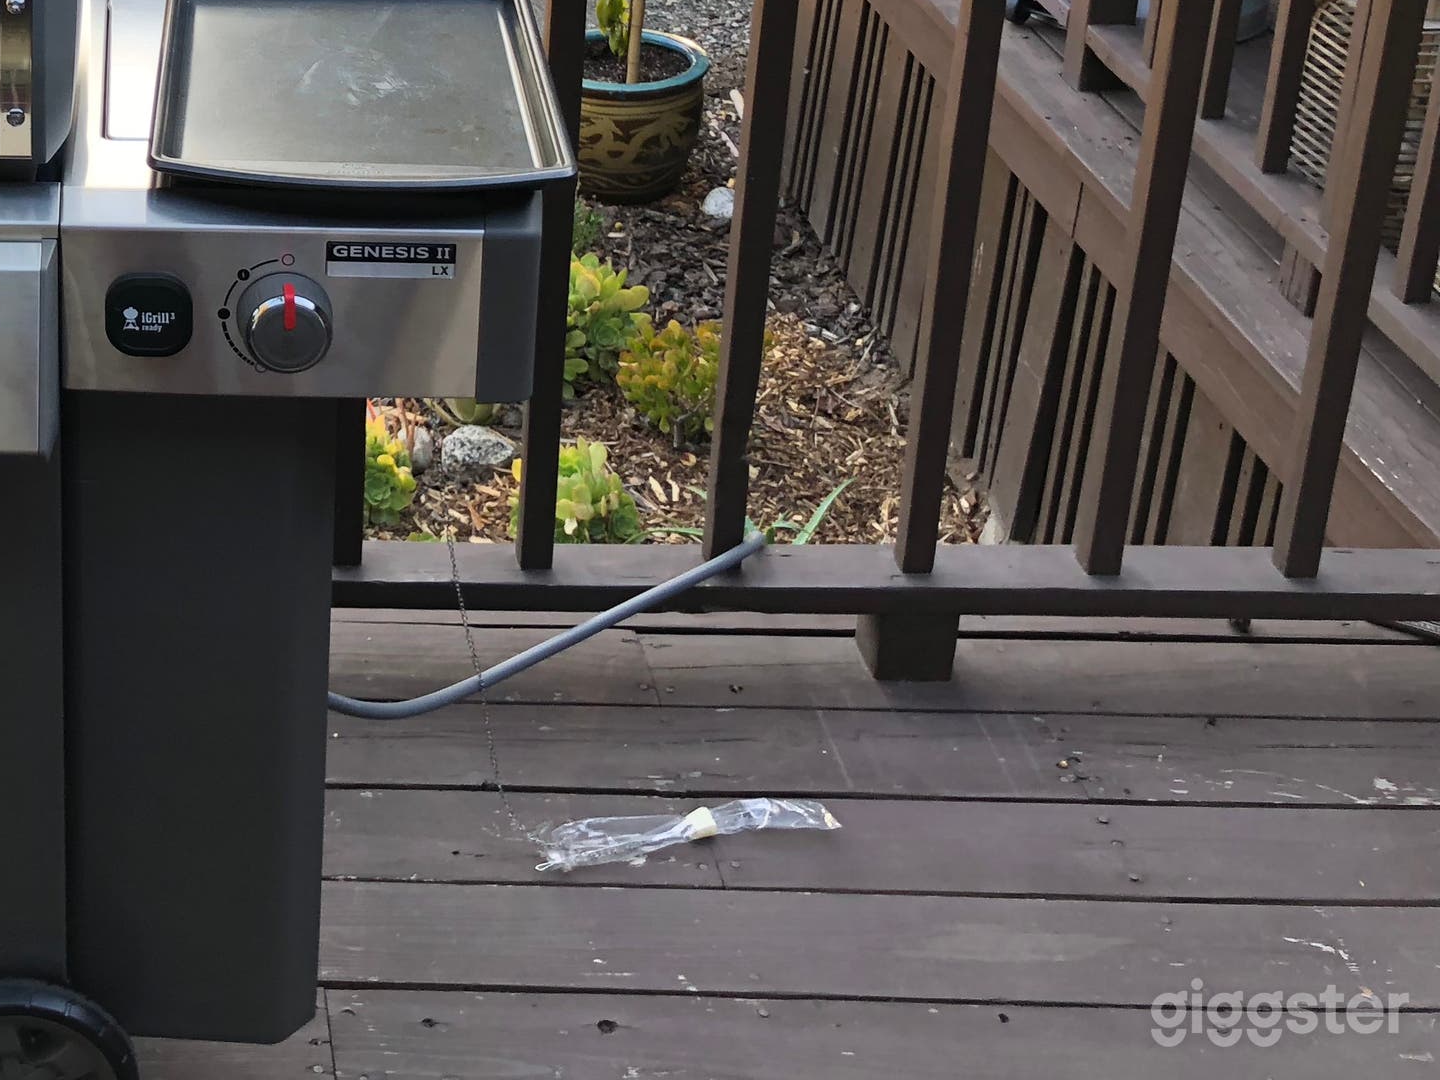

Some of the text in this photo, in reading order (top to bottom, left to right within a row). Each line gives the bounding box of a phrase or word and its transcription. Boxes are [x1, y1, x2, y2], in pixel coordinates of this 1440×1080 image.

[332, 245, 451, 260] GENESIS II
[432, 265, 449, 276] LX
[141, 324, 163, 333] ready
